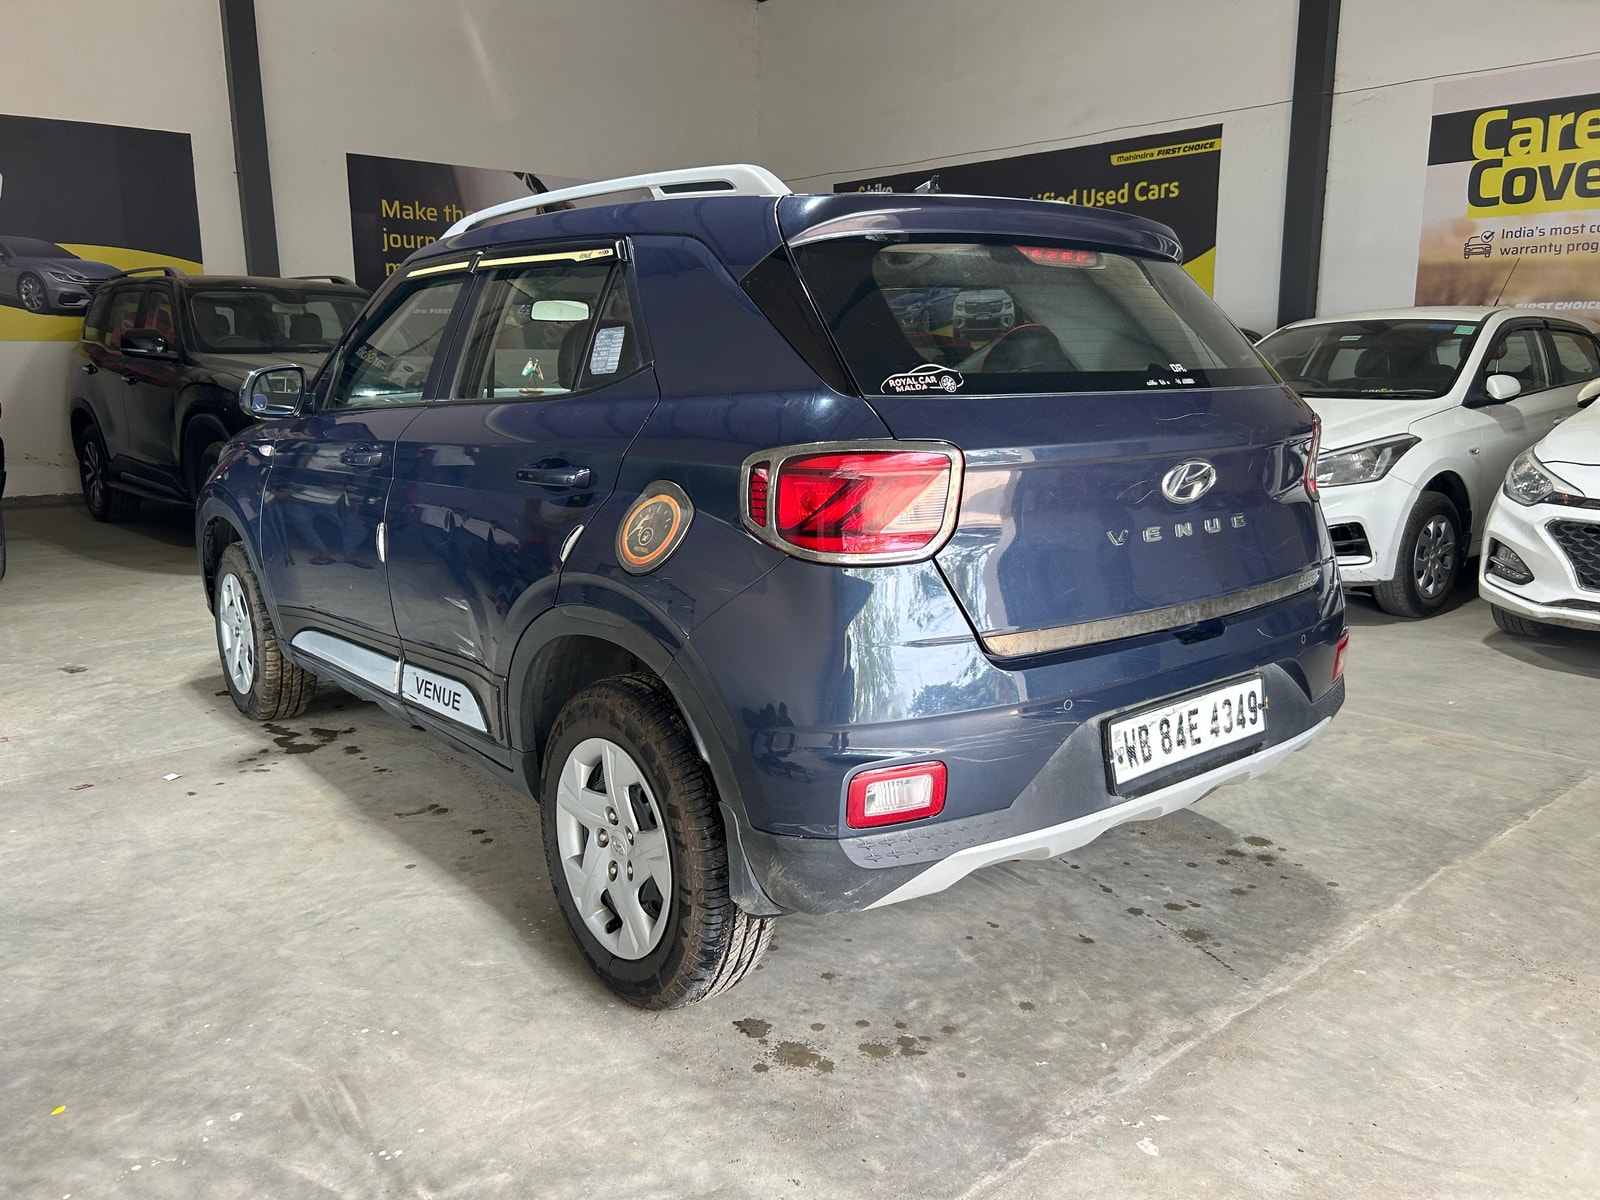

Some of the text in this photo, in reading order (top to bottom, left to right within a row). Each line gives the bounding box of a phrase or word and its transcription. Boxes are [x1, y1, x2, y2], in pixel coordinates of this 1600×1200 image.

[1472, 109, 1600, 160] Care
[1157, 147, 1182, 156] FIRST
[1182, 141, 1215, 153] CHOICE
[1082, 182, 1129, 207] Used
[1134, 181, 1179, 202] Cars
[381, 199, 473, 222] Make th
[1501, 226, 1545, 239] India's
[1550, 224, 1586, 236] most
[1500, 242, 1562, 255] warranty
[888, 375, 938, 387] ROYAL CAR
[895, 384, 928, 393] MALDA
[1106, 512, 1246, 546] VENUE
[415, 676, 461, 711] VENUE
[1123, 690, 1258, 769] WB 84E 4349
